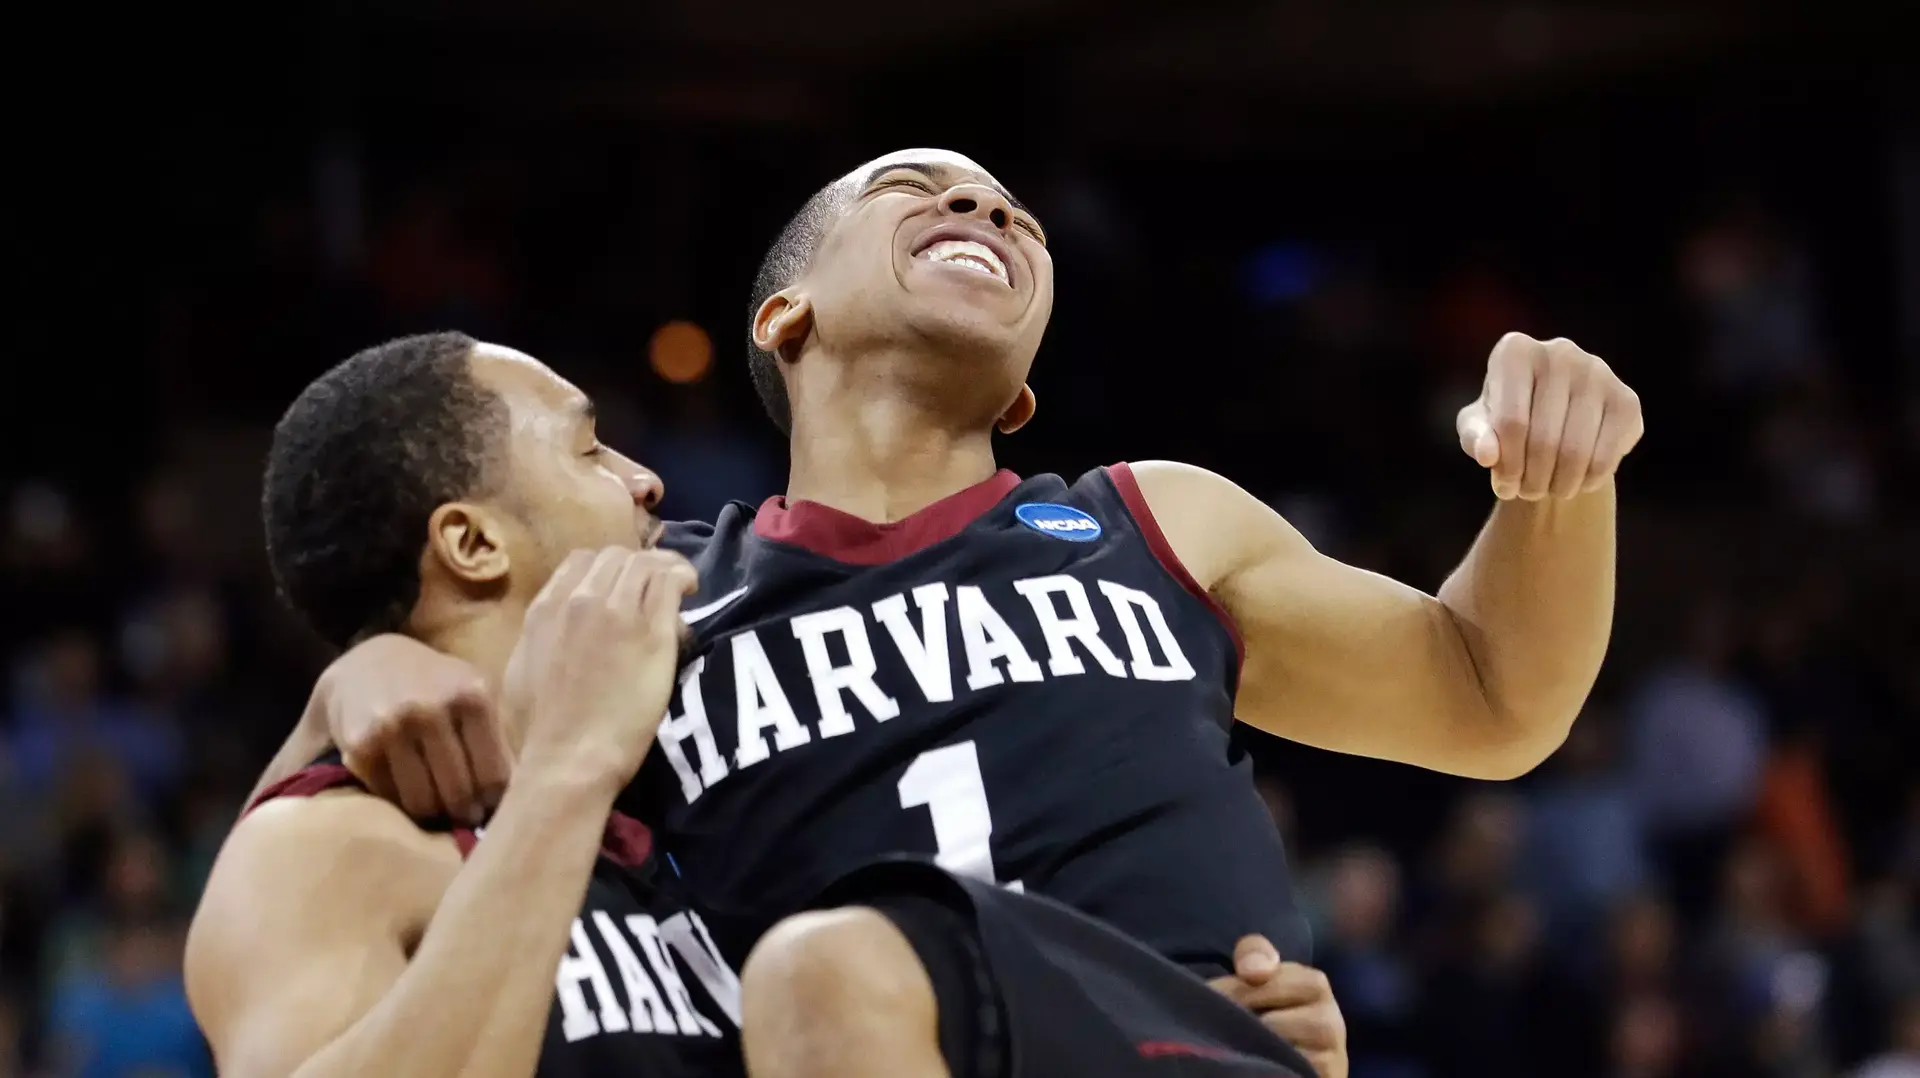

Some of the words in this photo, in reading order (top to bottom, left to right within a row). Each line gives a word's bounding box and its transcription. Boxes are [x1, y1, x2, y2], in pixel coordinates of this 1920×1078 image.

[1033, 519, 1099, 531] NCAA
[657, 574, 1196, 805] HARVARD
[898, 740, 1025, 895] 1
